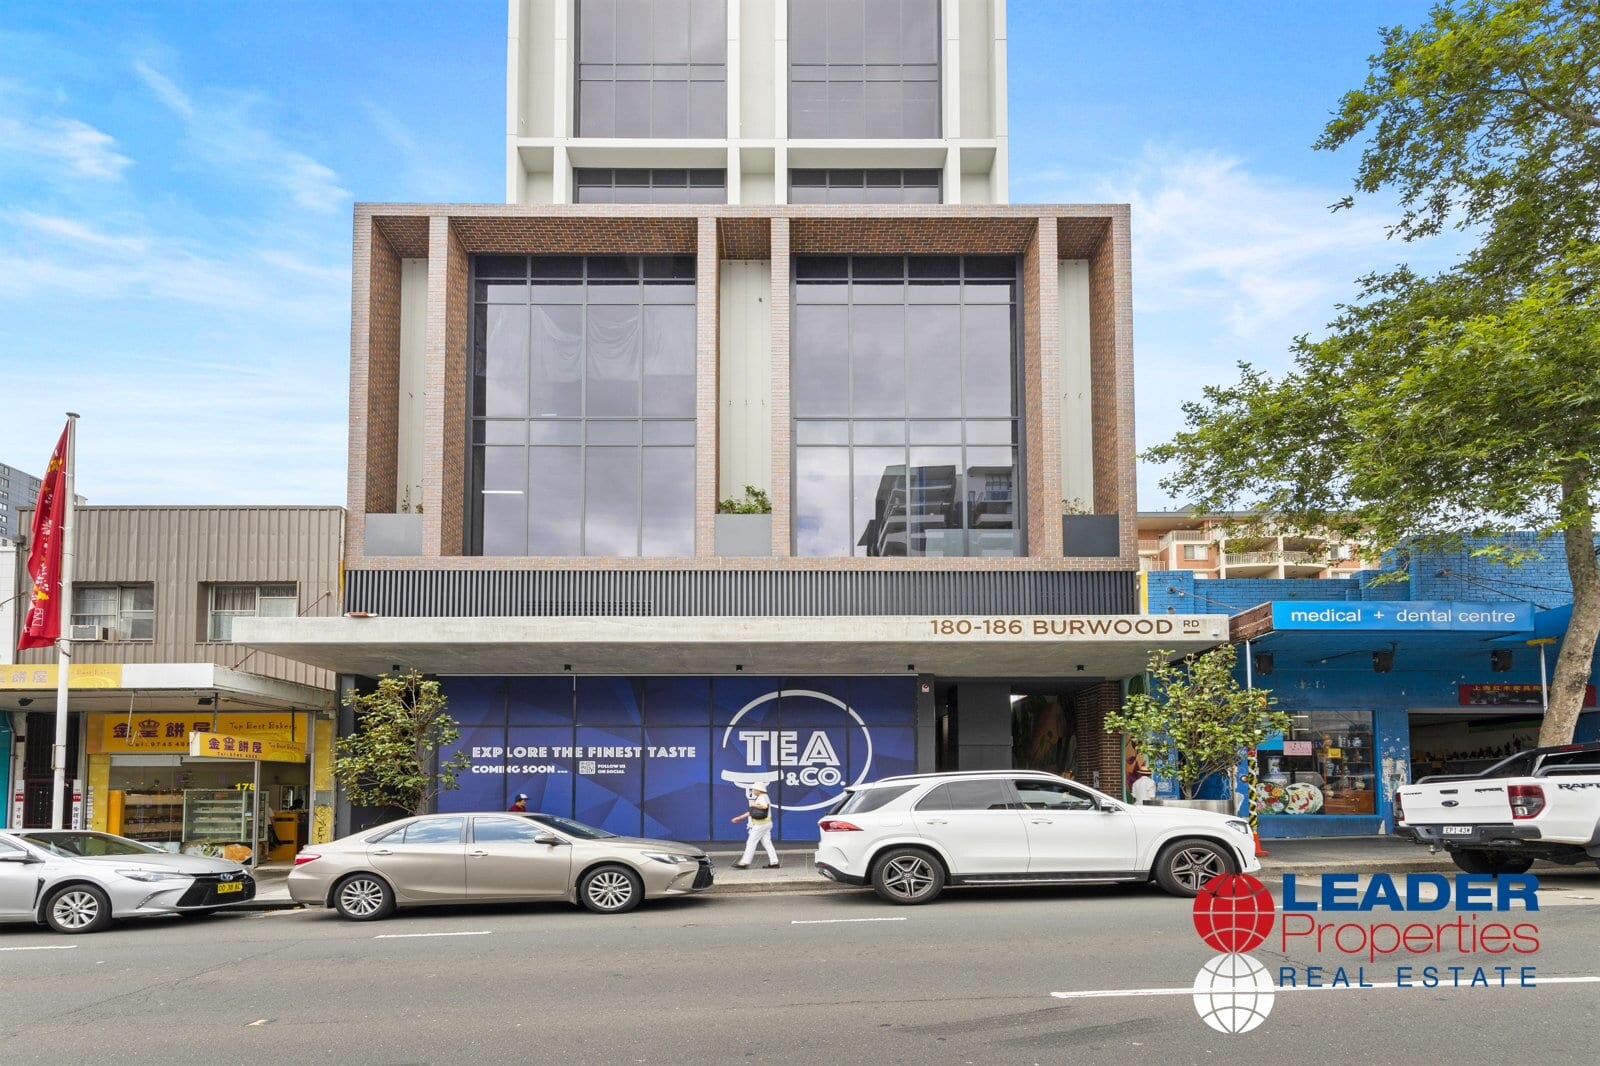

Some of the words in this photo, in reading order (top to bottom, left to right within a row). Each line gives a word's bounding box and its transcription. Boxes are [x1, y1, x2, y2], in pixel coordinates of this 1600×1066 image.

[1290, 608, 1361, 622] medical
[1396, 608, 1451, 622] dental
[1458, 610, 1516, 623] centre
[930, 619, 1023, 635] 180-186
[1033, 619, 1173, 635] BURWOOD
[1183, 620, 1200, 628] RD
[230, 722, 242, 731] Top
[246, 721, 265, 730] Best
[472, 746, 548, 758] EXPLORE
[552, 746, 584, 758] THE
[588, 746, 642, 758] FINEST
[648, 746, 696, 758] TASTE
[739, 731, 840, 766] TEA
[471, 764, 520, 774] COMING
[522, 764, 556, 774] SOON
[786, 767, 847, 787] &CO.
[235, 783, 255, 791] 178
